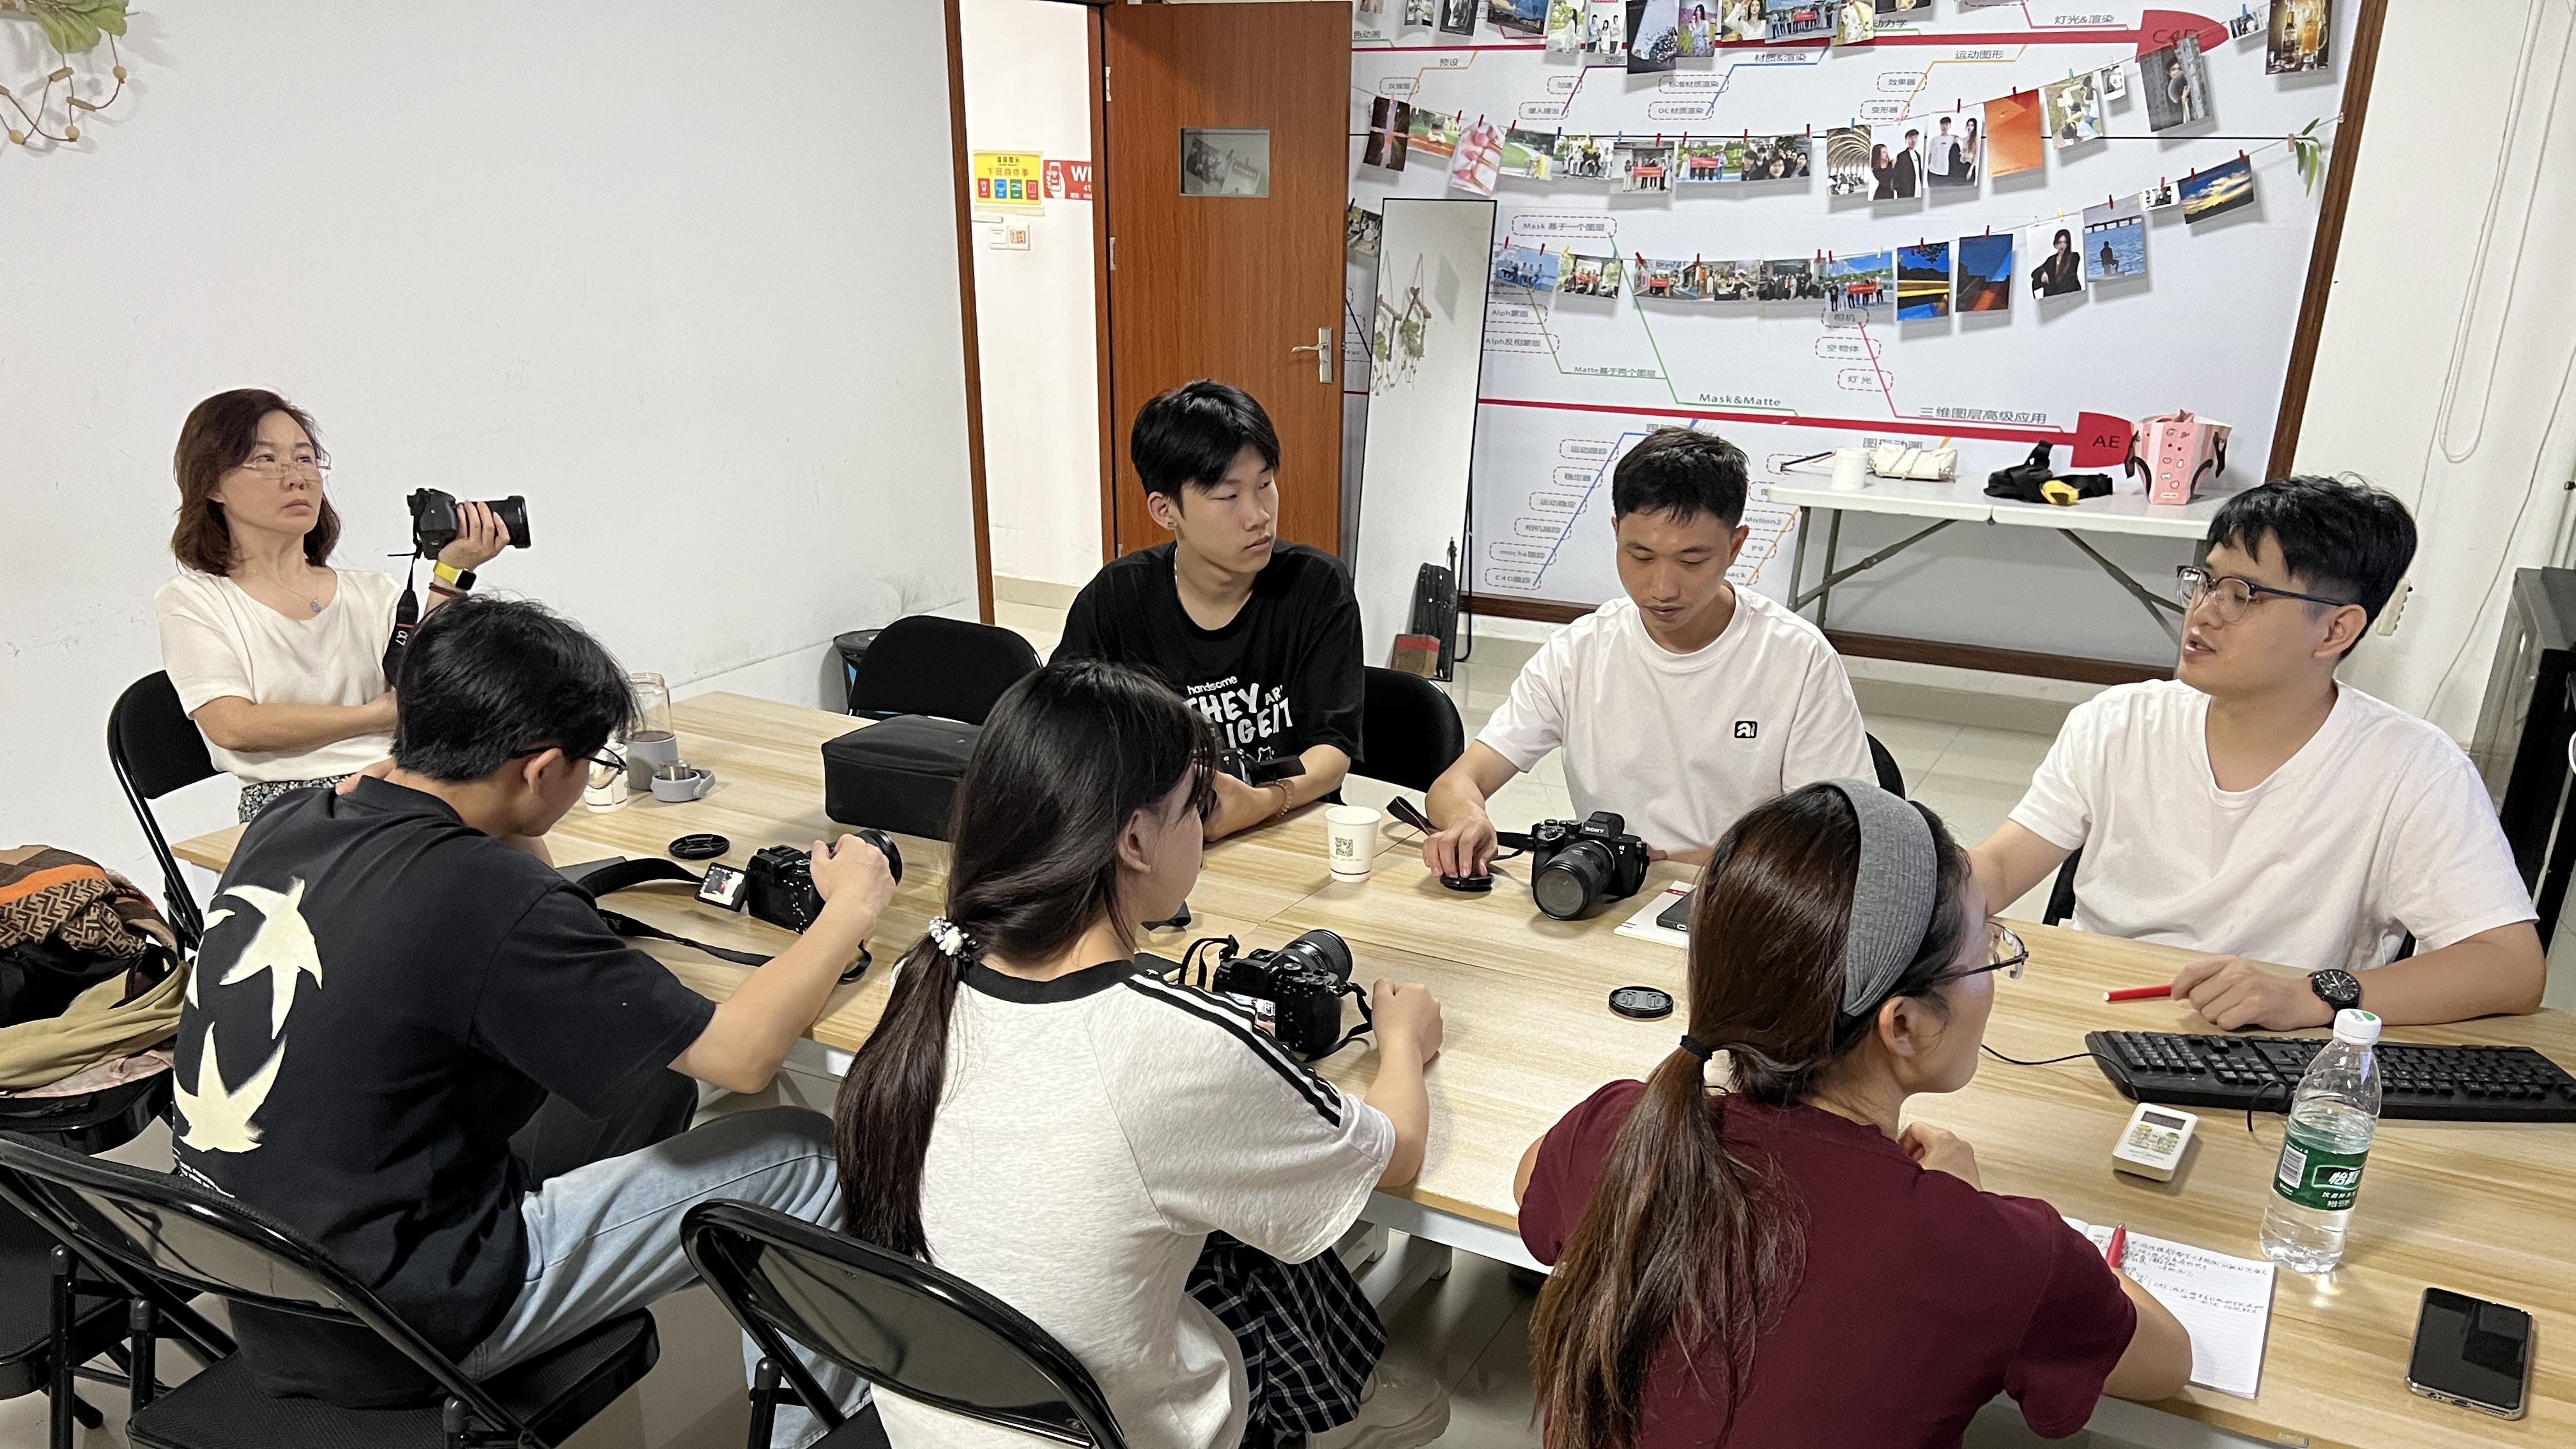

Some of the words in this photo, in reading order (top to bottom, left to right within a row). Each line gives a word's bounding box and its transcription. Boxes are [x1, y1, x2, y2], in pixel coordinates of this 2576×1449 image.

[1754, 54, 1807, 63] 材质&渲染
[1954, 50, 2004, 59] 运动图形
[1699, 393, 1781, 406] Mask&Matte
[1920, 406, 2047, 424] 三维图层高级应用
[2092, 435, 2120, 448] AE
[1186, 675, 1238, 696] handsome
[1183, 682, 1260, 724] THEY
